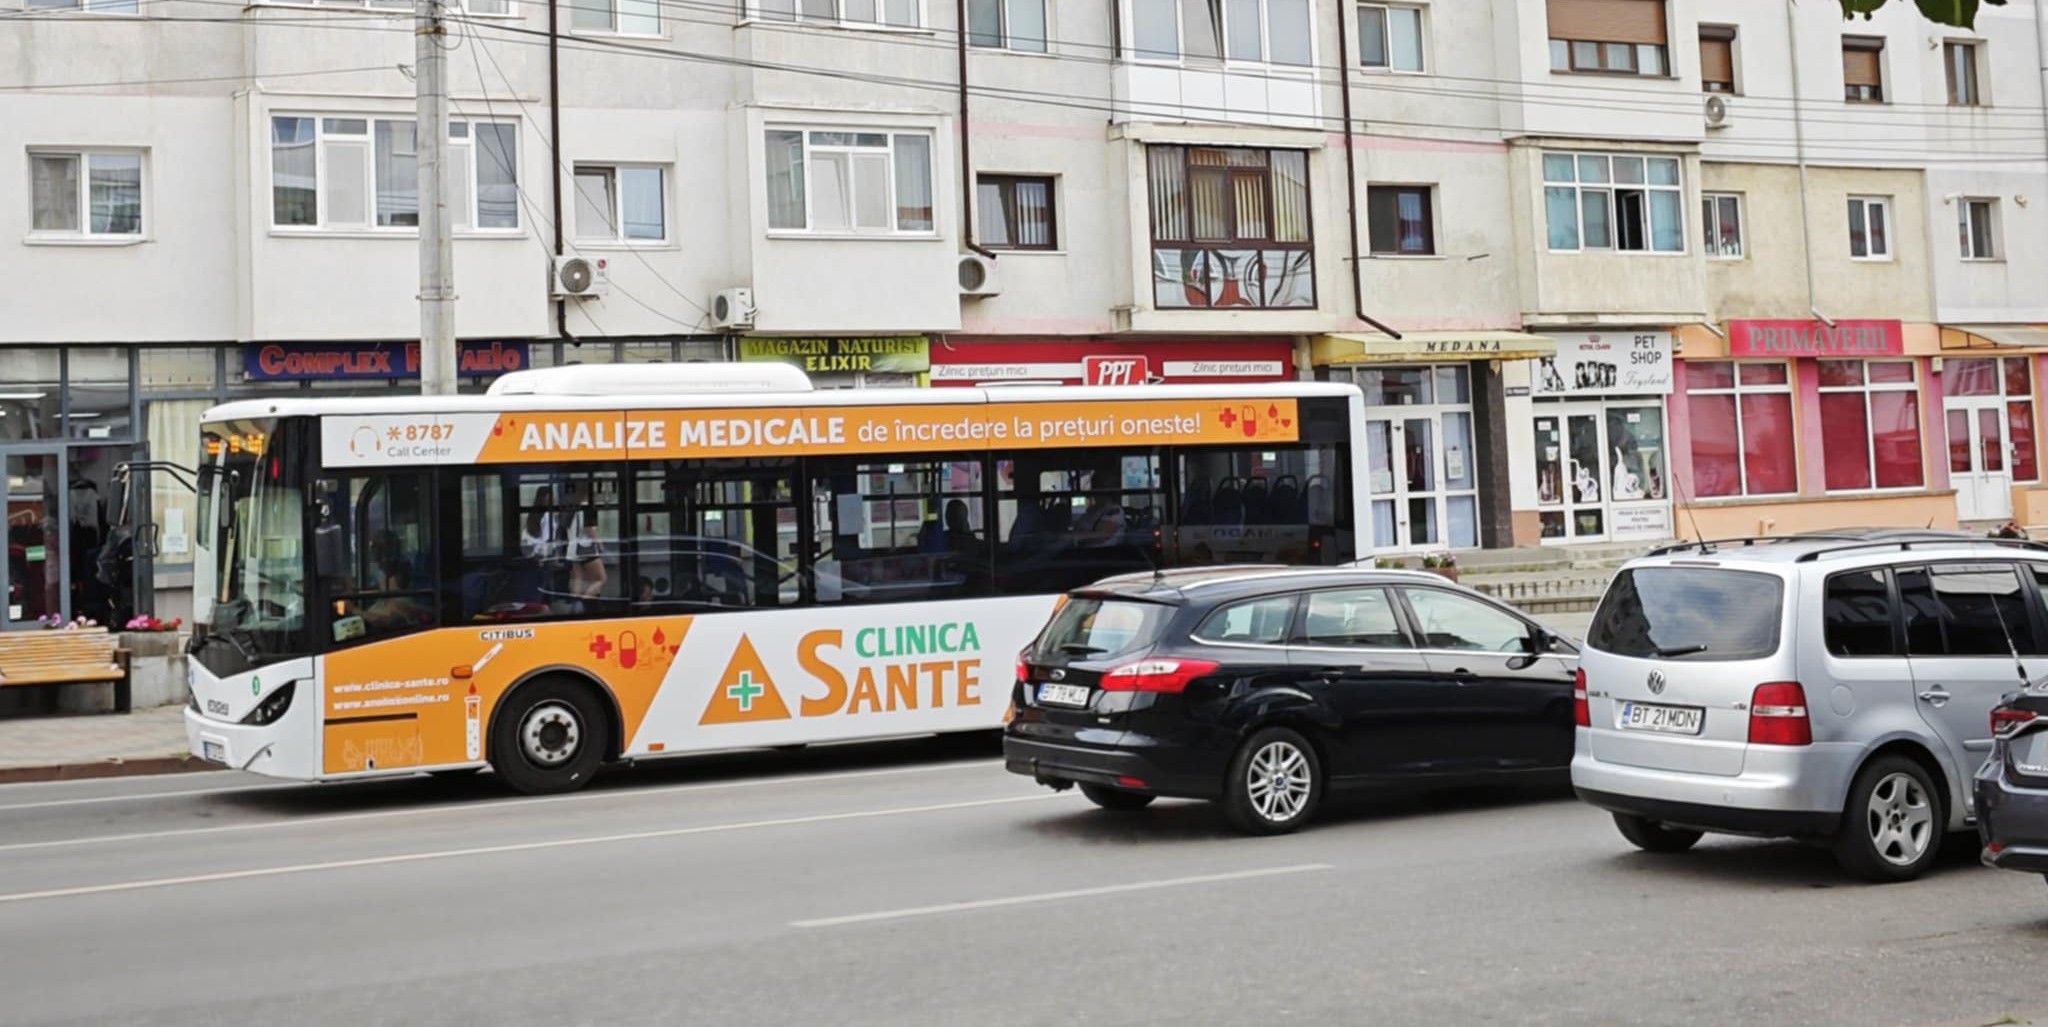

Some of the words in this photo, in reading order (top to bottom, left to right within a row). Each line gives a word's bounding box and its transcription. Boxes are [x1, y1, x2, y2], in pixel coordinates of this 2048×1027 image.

[750, 338, 829, 355] MAGAZIN
[837, 337, 921, 354] NATURIST
[1426, 341, 1500, 352] MEDANA
[1634, 335, 1656, 349] PET
[805, 355, 872, 371] ELIXIR
[1630, 351, 1662, 365] SHOP
[520, 421, 666, 450] ANALIZE
[680, 417, 845, 447] MEDICALE
[858, 421, 888, 442] de
[895, 416, 1006, 441] încredere
[1014, 416, 1032, 438] la
[1040, 414, 1115, 442] prețuri
[1121, 412, 1200, 434] oneste!
[387, 446, 410, 457] Call
[412, 446, 451, 457] Center
[480, 629, 533, 640] CITIBUS
[855, 622, 980, 658] CLINICA
[796, 629, 981, 717] SANTE
[1632, 706, 1649, 723] BT
